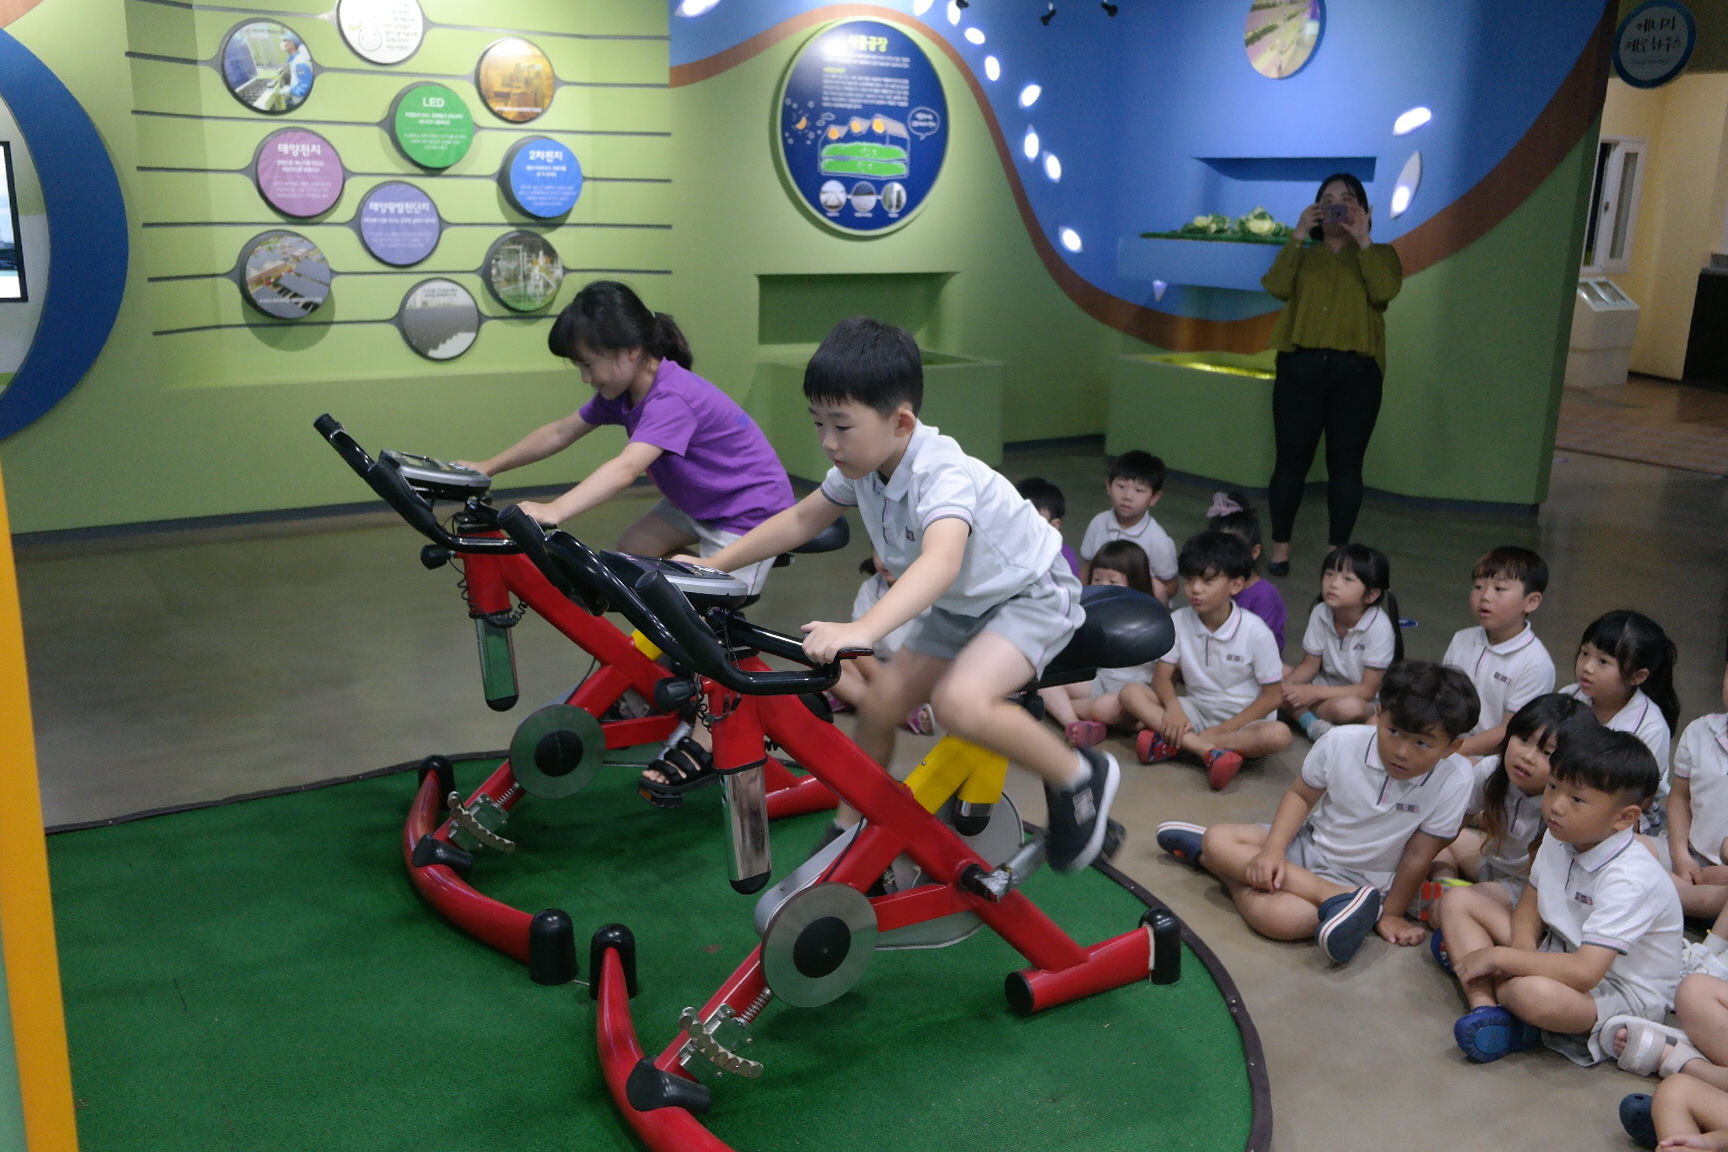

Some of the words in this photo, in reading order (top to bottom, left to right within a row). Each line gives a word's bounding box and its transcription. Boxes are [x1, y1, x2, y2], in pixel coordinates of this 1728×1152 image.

[1637, 16, 1676, 32] 에너지
[1625, 36, 1682, 53] 제로하우스
[422, 96, 446, 108] LED
[277, 143, 322, 157] 태양전지
[529, 150, 563, 163] 2차전지
[369, 202, 430, 215] 태양광발전단지
